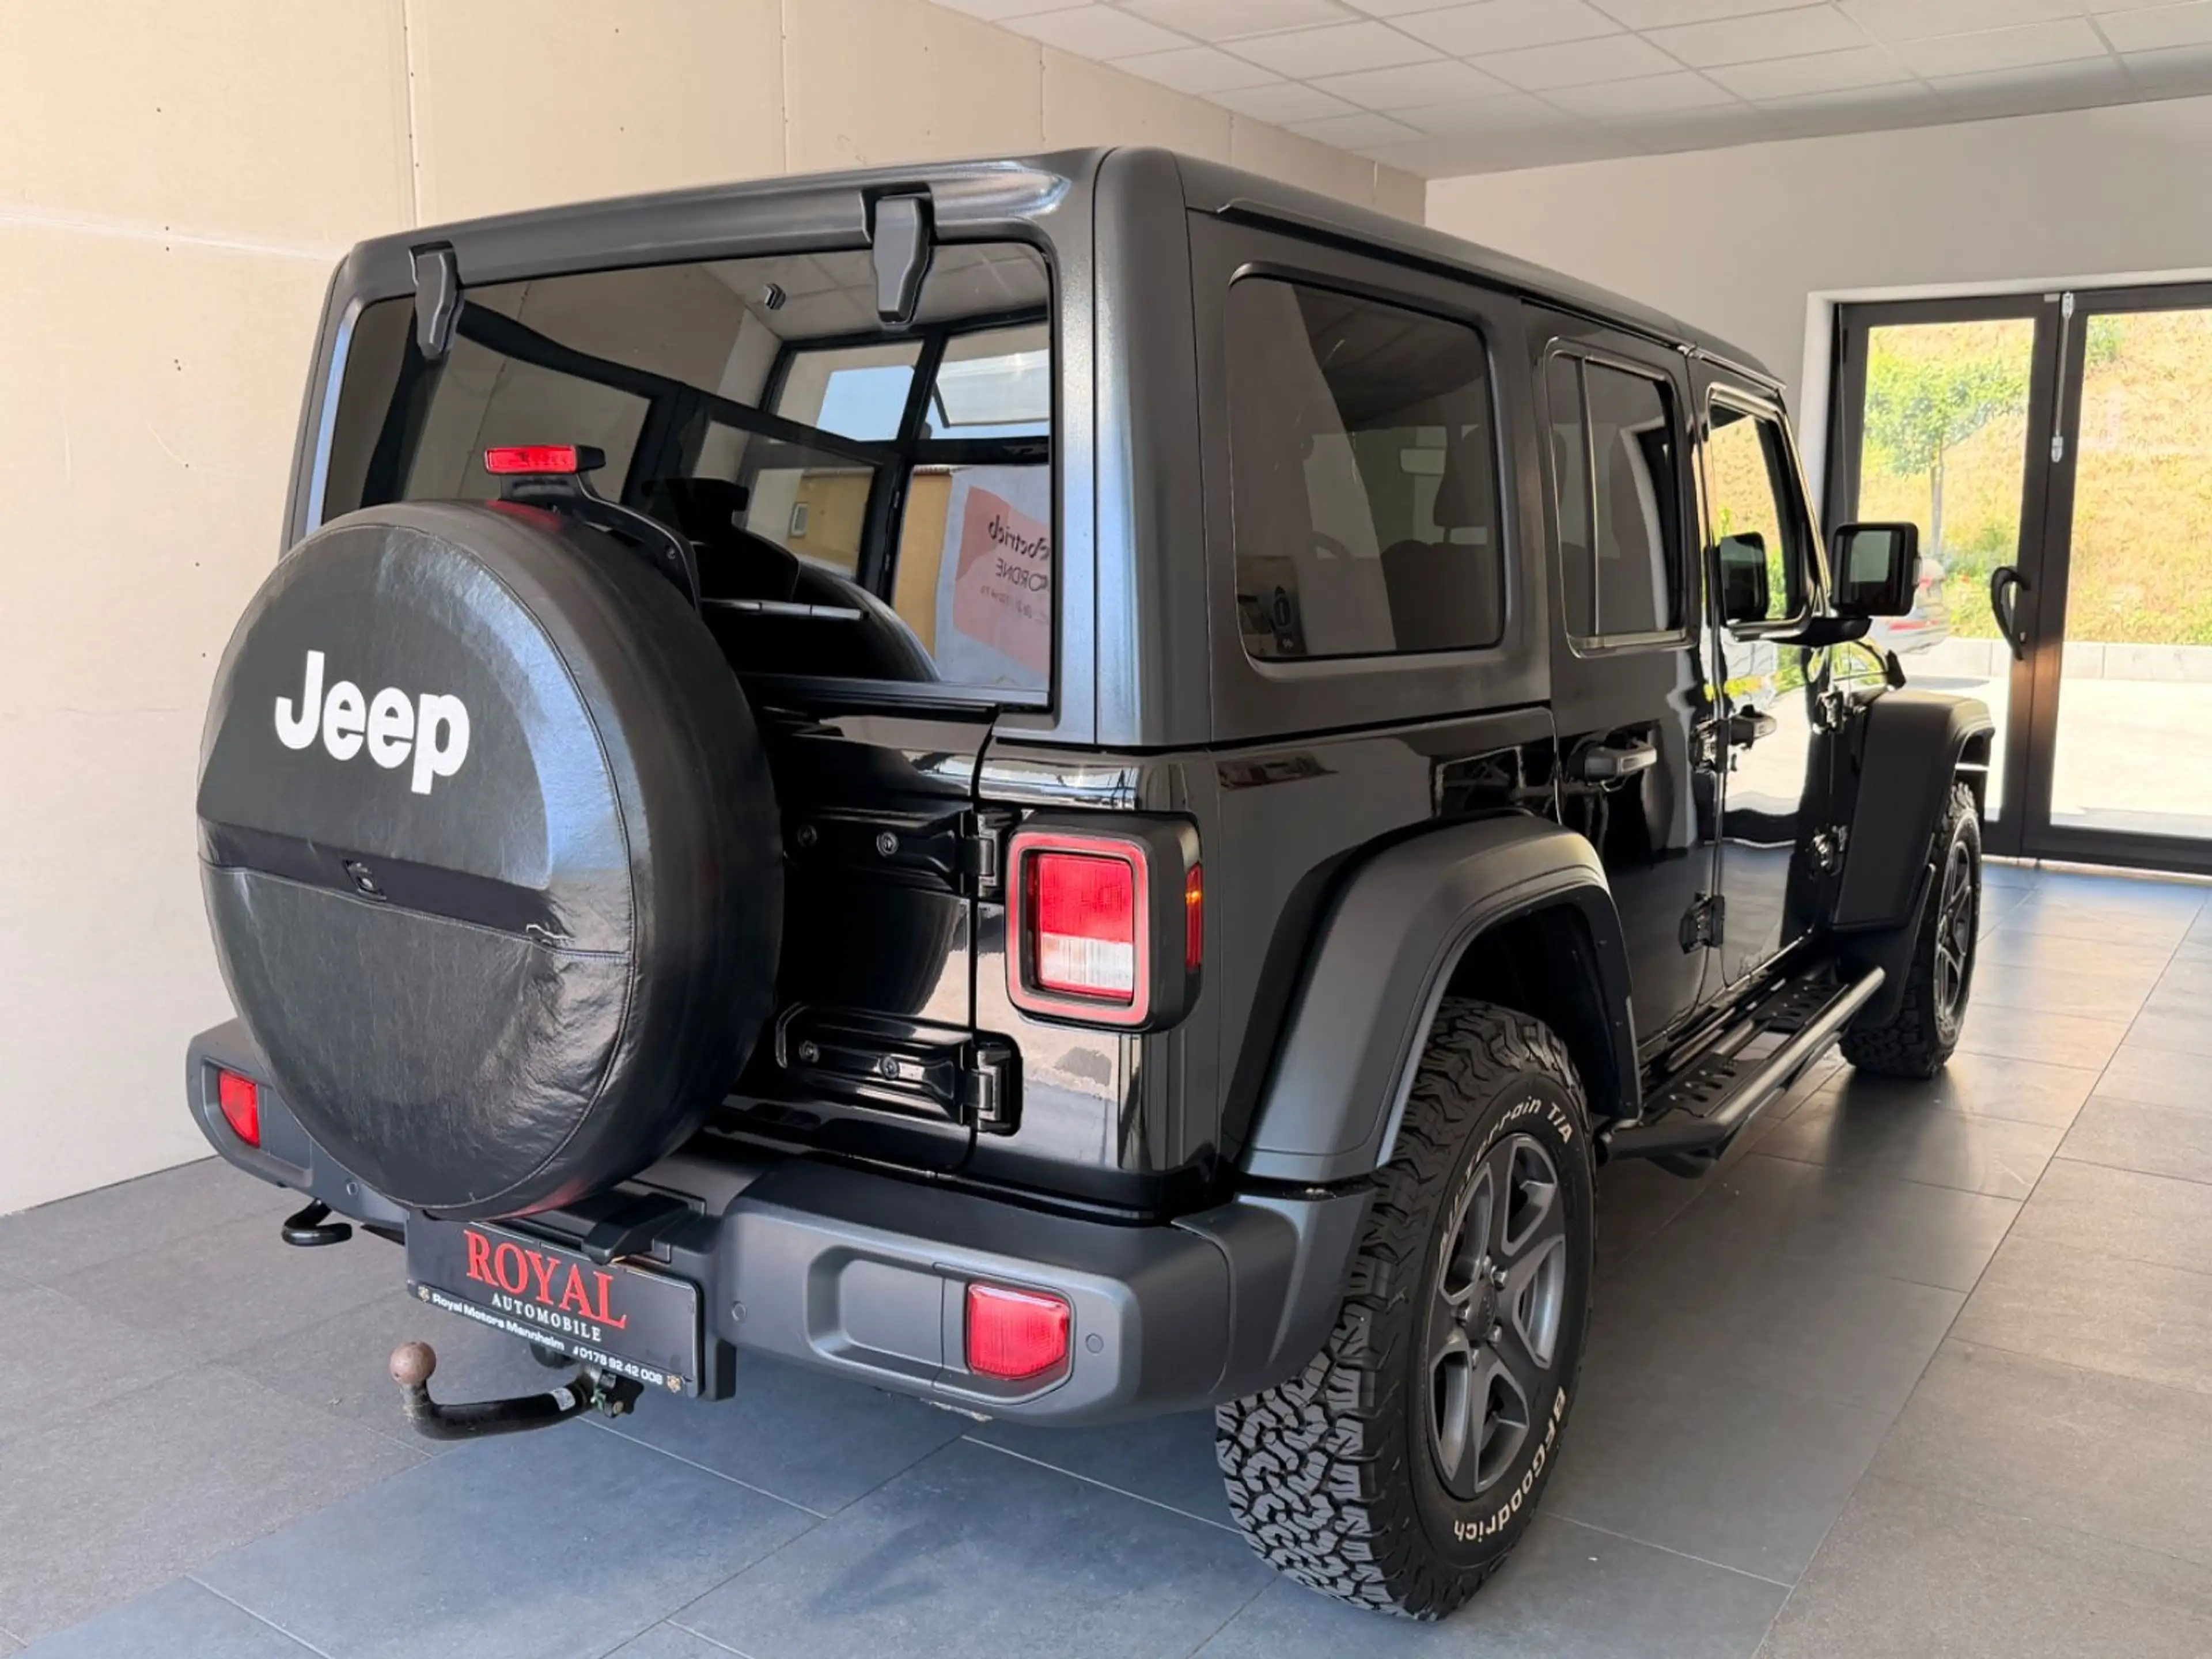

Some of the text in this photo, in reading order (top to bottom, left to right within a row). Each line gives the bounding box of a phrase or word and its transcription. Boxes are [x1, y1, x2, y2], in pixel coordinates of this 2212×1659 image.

[275, 650, 469, 794] Jeep
[1547, 1101, 1573, 1144] T/A
[463, 1229, 627, 1329] ROYAL
[491, 1292, 601, 1342] AUTOMOBILE
[432, 1293, 463, 1313] Royal
[463, 1303, 505, 1328] Motors
[506, 1320, 565, 1351] Mannheim
[1454, 1386, 1566, 1543] BFGoodrich
